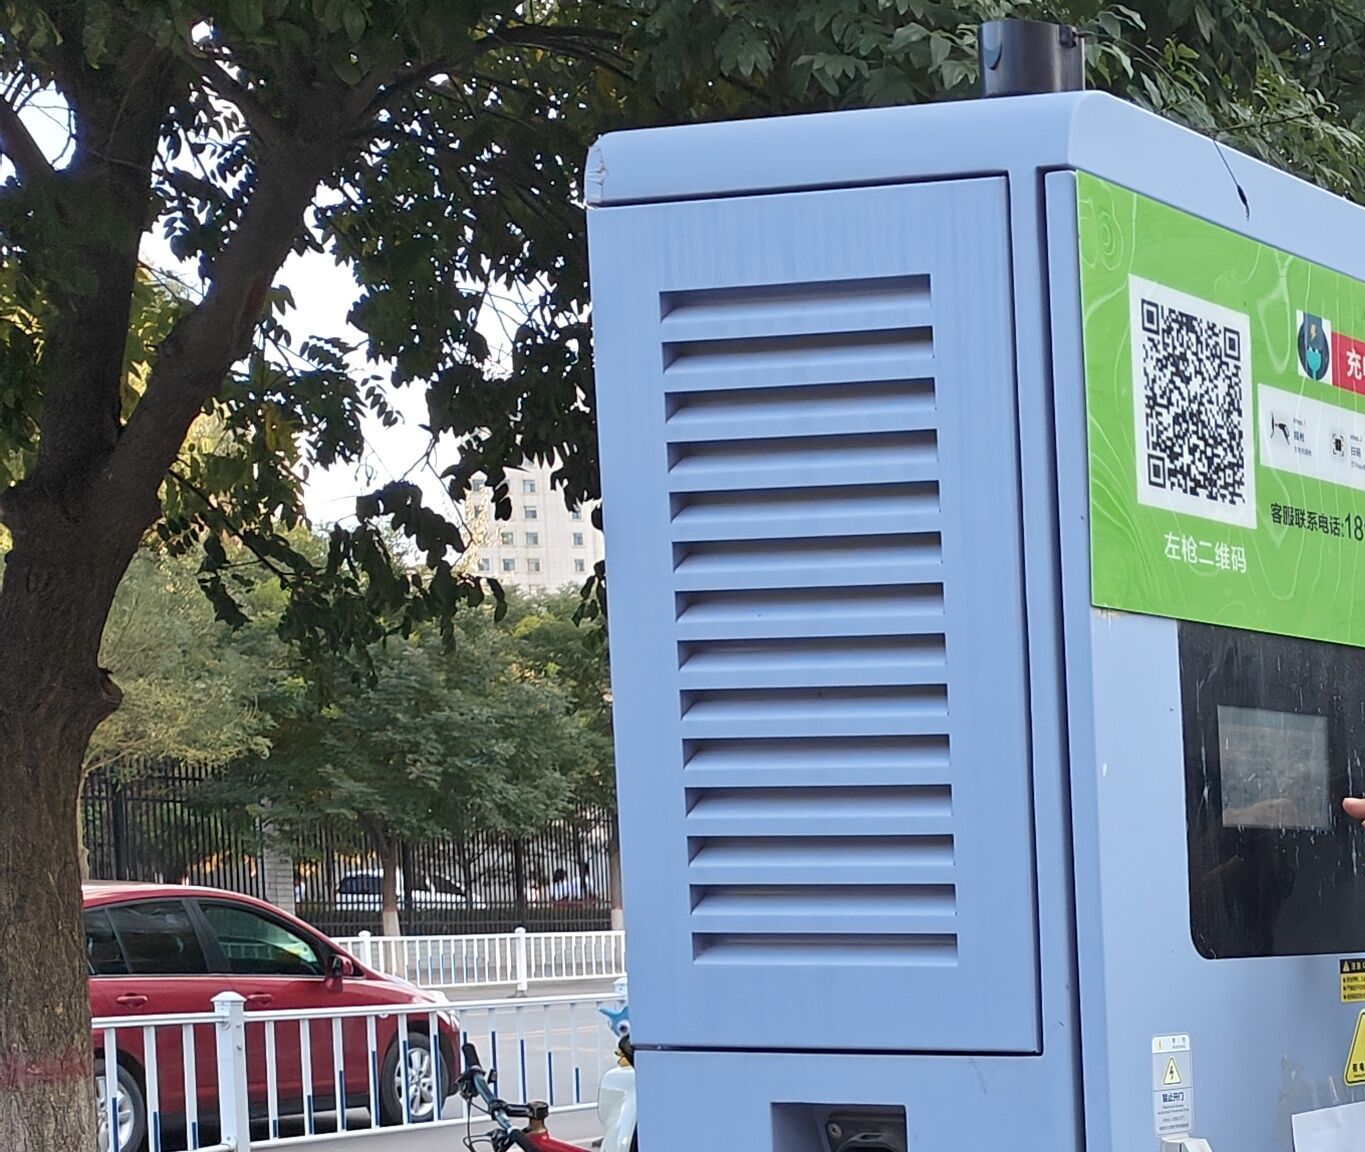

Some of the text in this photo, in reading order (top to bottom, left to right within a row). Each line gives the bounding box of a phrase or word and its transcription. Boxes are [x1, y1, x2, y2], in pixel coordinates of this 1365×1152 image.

[1164, 531, 1247, 574] 左枪二维码
